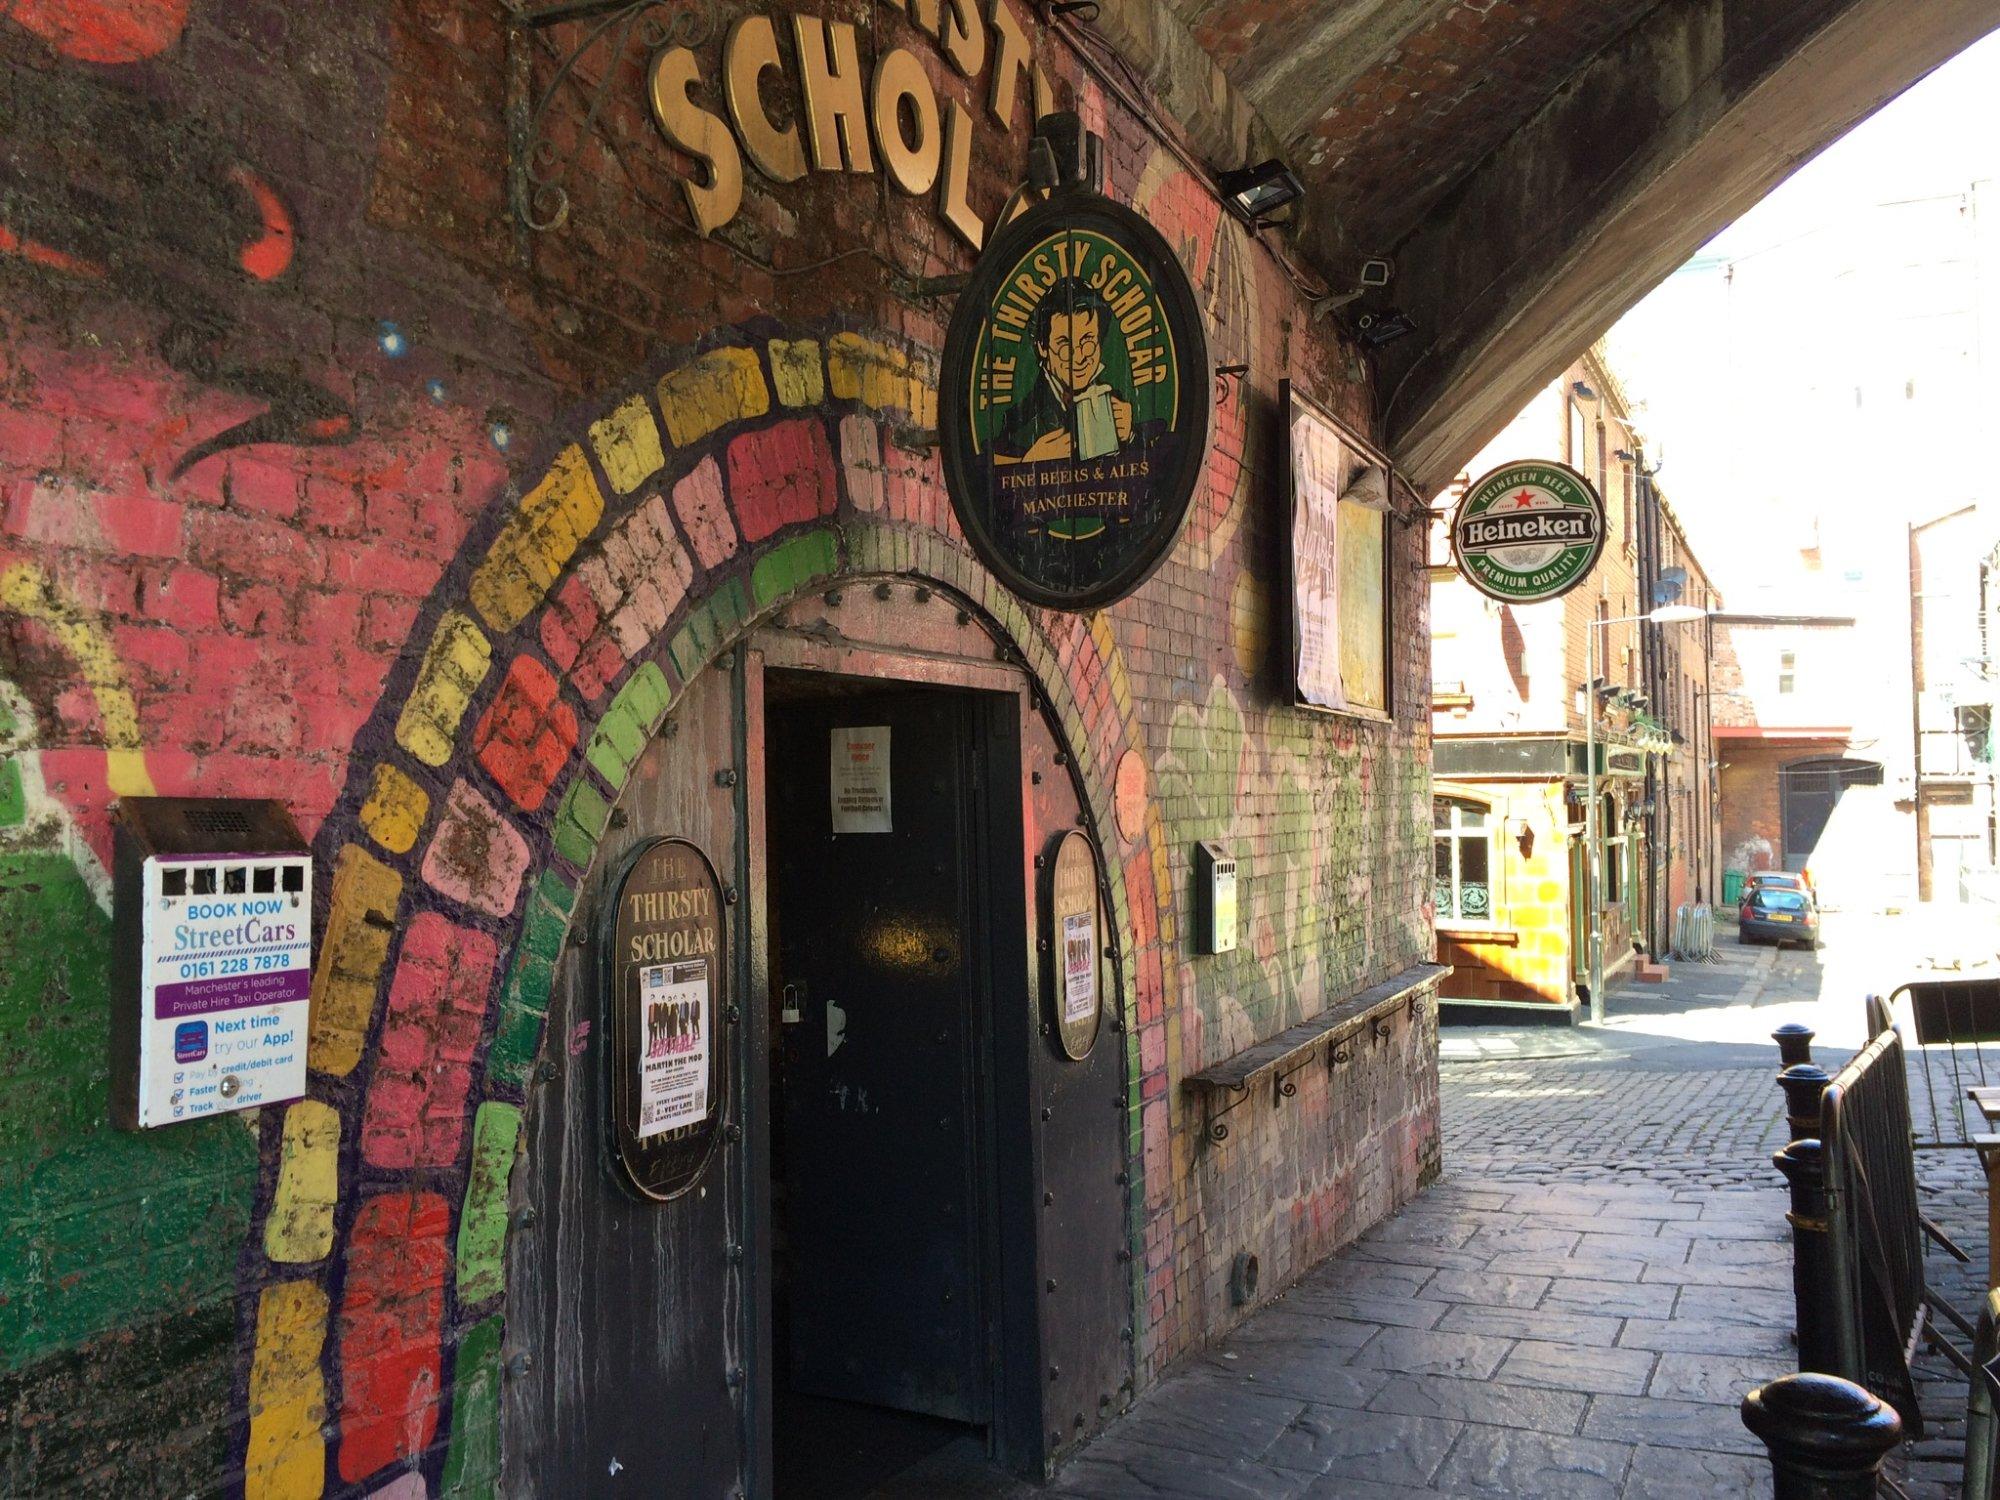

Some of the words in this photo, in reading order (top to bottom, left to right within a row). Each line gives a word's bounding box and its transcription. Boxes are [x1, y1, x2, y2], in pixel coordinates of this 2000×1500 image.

[649, 13, 1040, 252] SCHOL
[992, 240, 1091, 342] THIRSTY
[1092, 254, 1167, 387] SCHOLAR
[980, 353, 1017, 410] THE
[1002, 472, 1035, 490] FINE
[1041, 467, 1089, 485] BEERS
[1094, 467, 1105, 481] &
[1110, 461, 1150, 479] ALES
[1480, 472, 1537, 503] HEINEKEN
[1543, 473, 1572, 497] BEER
[1023, 491, 1128, 515] MANCHESTER
[1469, 516, 1585, 544] Heineken
[1477, 559, 1527, 588] PREMIUM
[1532, 551, 1578, 585] QUALITY
[1060, 866, 1092, 889] THIRST
[188, 903, 237, 920] BOOK
[243, 900, 283, 916] NOW
[630, 888, 710, 923] THIRSTY
[174, 918, 296, 951] StreetCars
[631, 927, 716, 962] SCHOLAR
[180, 961, 214, 978] 0161
[221, 958, 248, 974] 228
[254, 954, 290, 971] 7878
[185, 979, 249, 995] Manchester's
[252, 976, 285, 990] leading
[173, 999, 208, 1012] Private
[210, 995, 230, 1007] Hire
[233, 993, 251, 1004] Taxi
[254, 988, 296, 1003] Operator
[215, 1019, 246, 1034] Next
[251, 1014, 280, 1029] time
[214, 1042, 233, 1056] try
[237, 1038, 258, 1049] our
[263, 1031, 294, 1047] App!
[190, 1067, 205, 1081] Pay
[221, 1056, 272, 1074] credit/debit
[275, 1053, 293, 1066] card
[645, 1060, 673, 1073] MARTIN
[674, 1057, 687, 1066] THE
[689, 1053, 703, 1063] MOD
[190, 1084, 217, 1096] Faster
[190, 1101, 213, 1113] Track
[237, 1092, 262, 1104] driver
